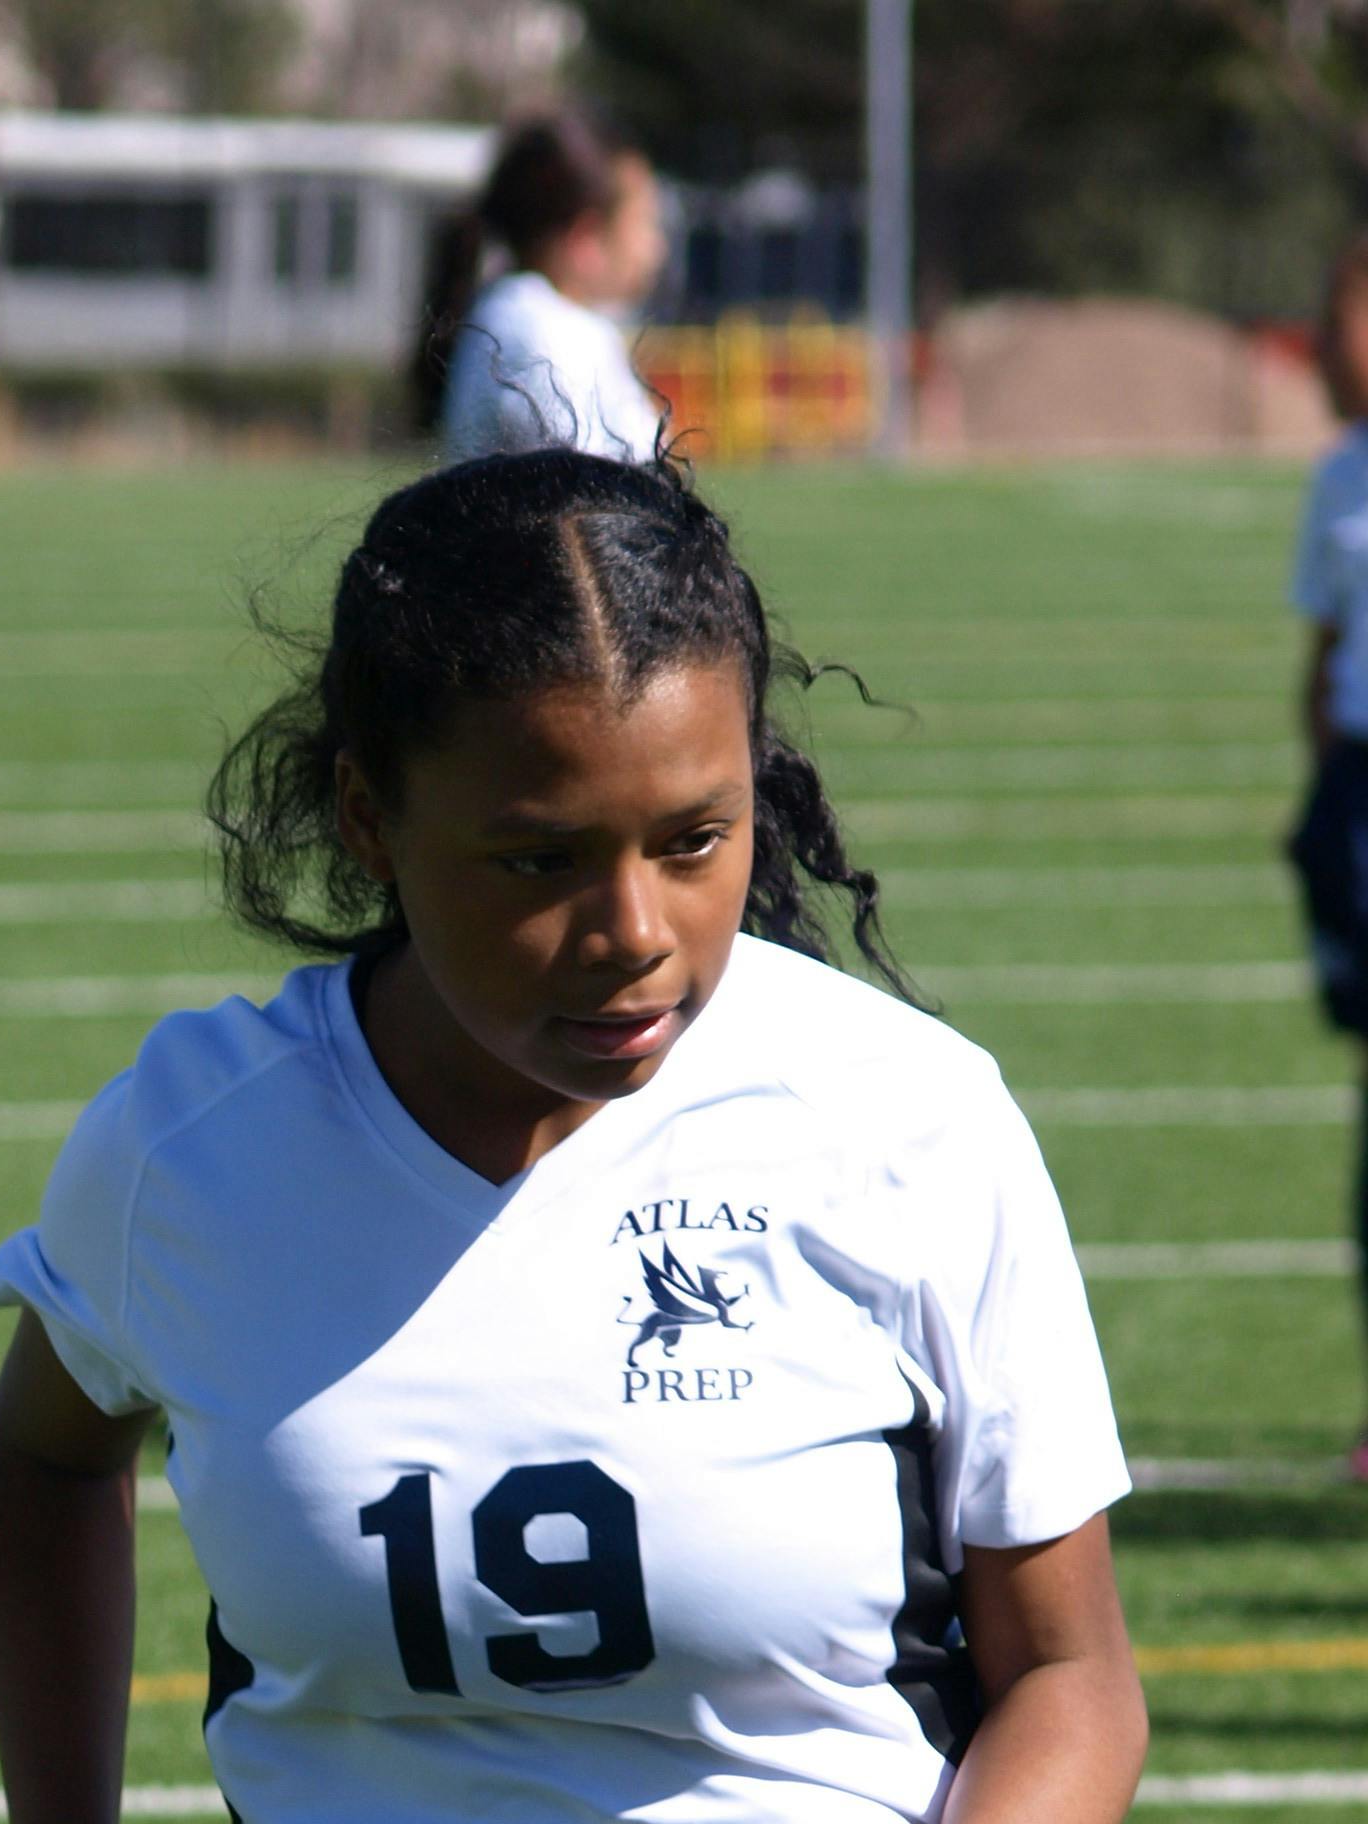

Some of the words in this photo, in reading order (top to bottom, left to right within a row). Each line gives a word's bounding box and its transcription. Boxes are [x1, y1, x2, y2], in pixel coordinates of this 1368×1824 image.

[609, 1199, 769, 1246] ATLAS
[621, 1367, 754, 1404] PREP
[358, 1458, 657, 1699] 19
